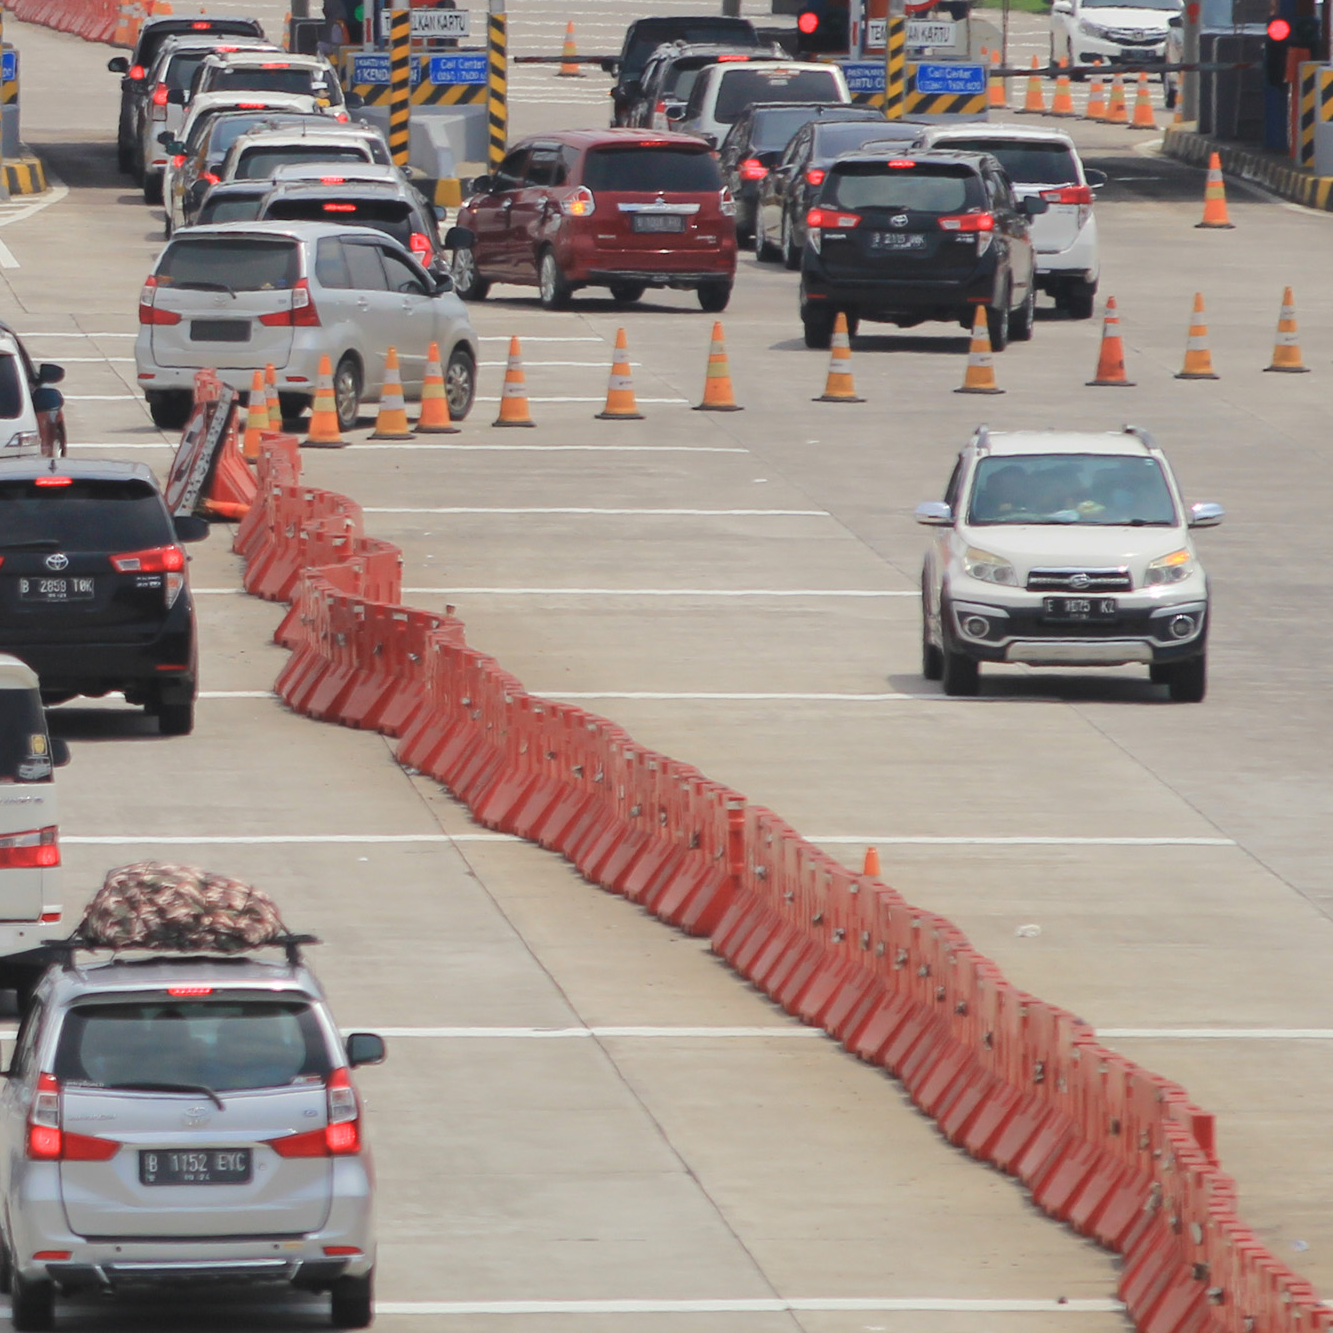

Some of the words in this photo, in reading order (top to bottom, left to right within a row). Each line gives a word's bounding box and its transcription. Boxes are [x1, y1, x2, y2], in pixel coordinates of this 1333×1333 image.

[438, 16, 465, 31] KARTU
[458, 60, 486, 69] Center
[23, 580, 30, 592] B
[1047, 601, 1054, 612] E
[149, 1154, 157, 1172] B
[172, 1153, 207, 1171] 1152
